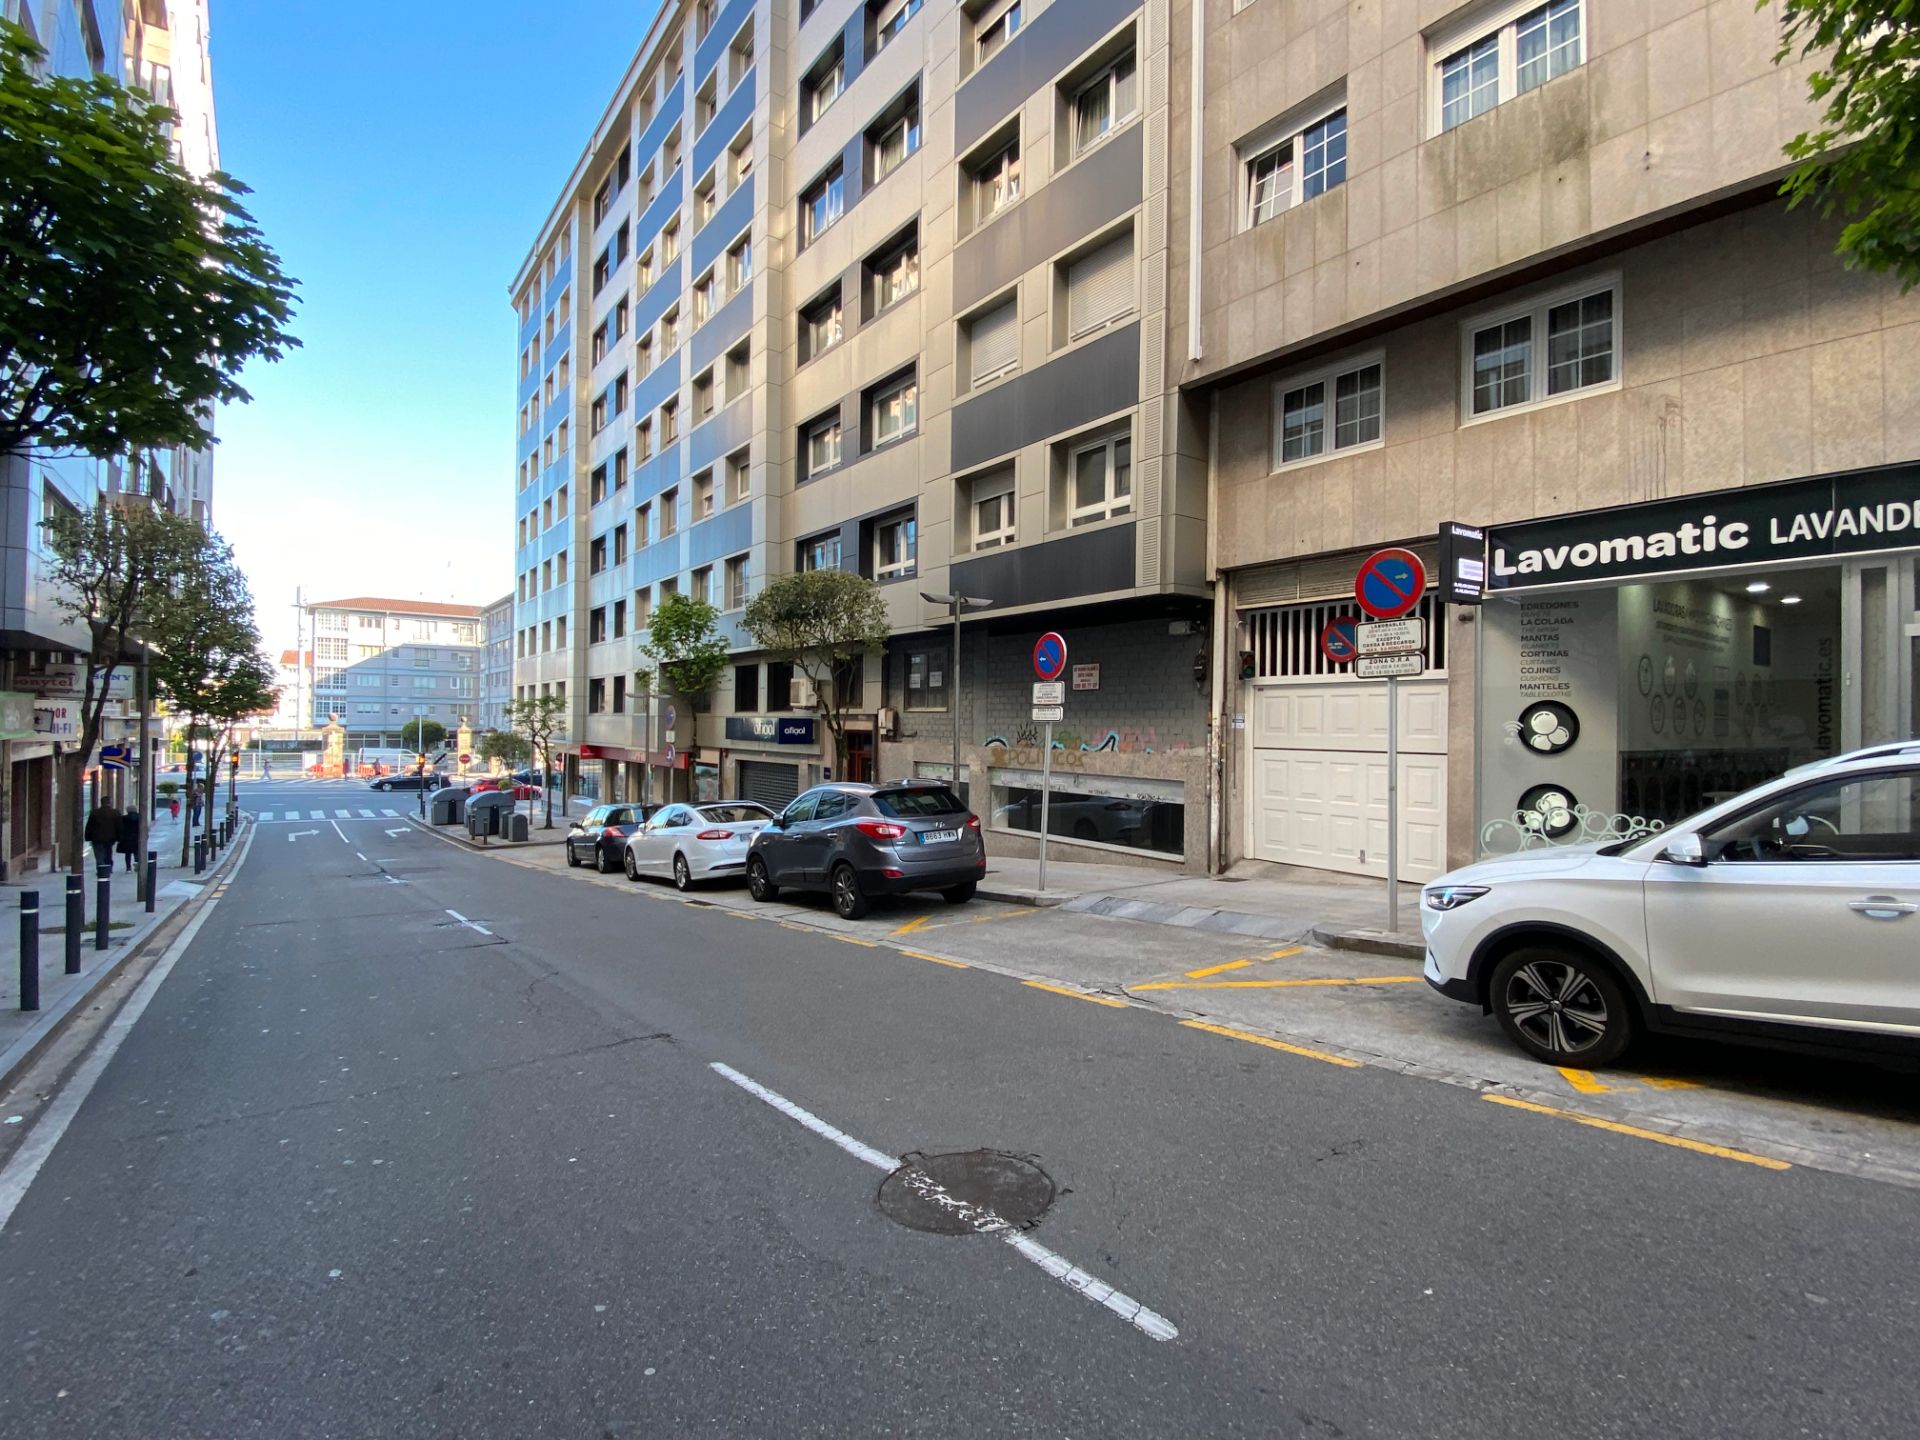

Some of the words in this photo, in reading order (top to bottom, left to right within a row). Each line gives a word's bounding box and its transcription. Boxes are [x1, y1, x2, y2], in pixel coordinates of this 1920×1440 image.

[1494, 514, 1750, 577] Lavomatic
[1520, 633, 1559, 642] MANTAS
[1520, 666, 1561, 674] COJINES
